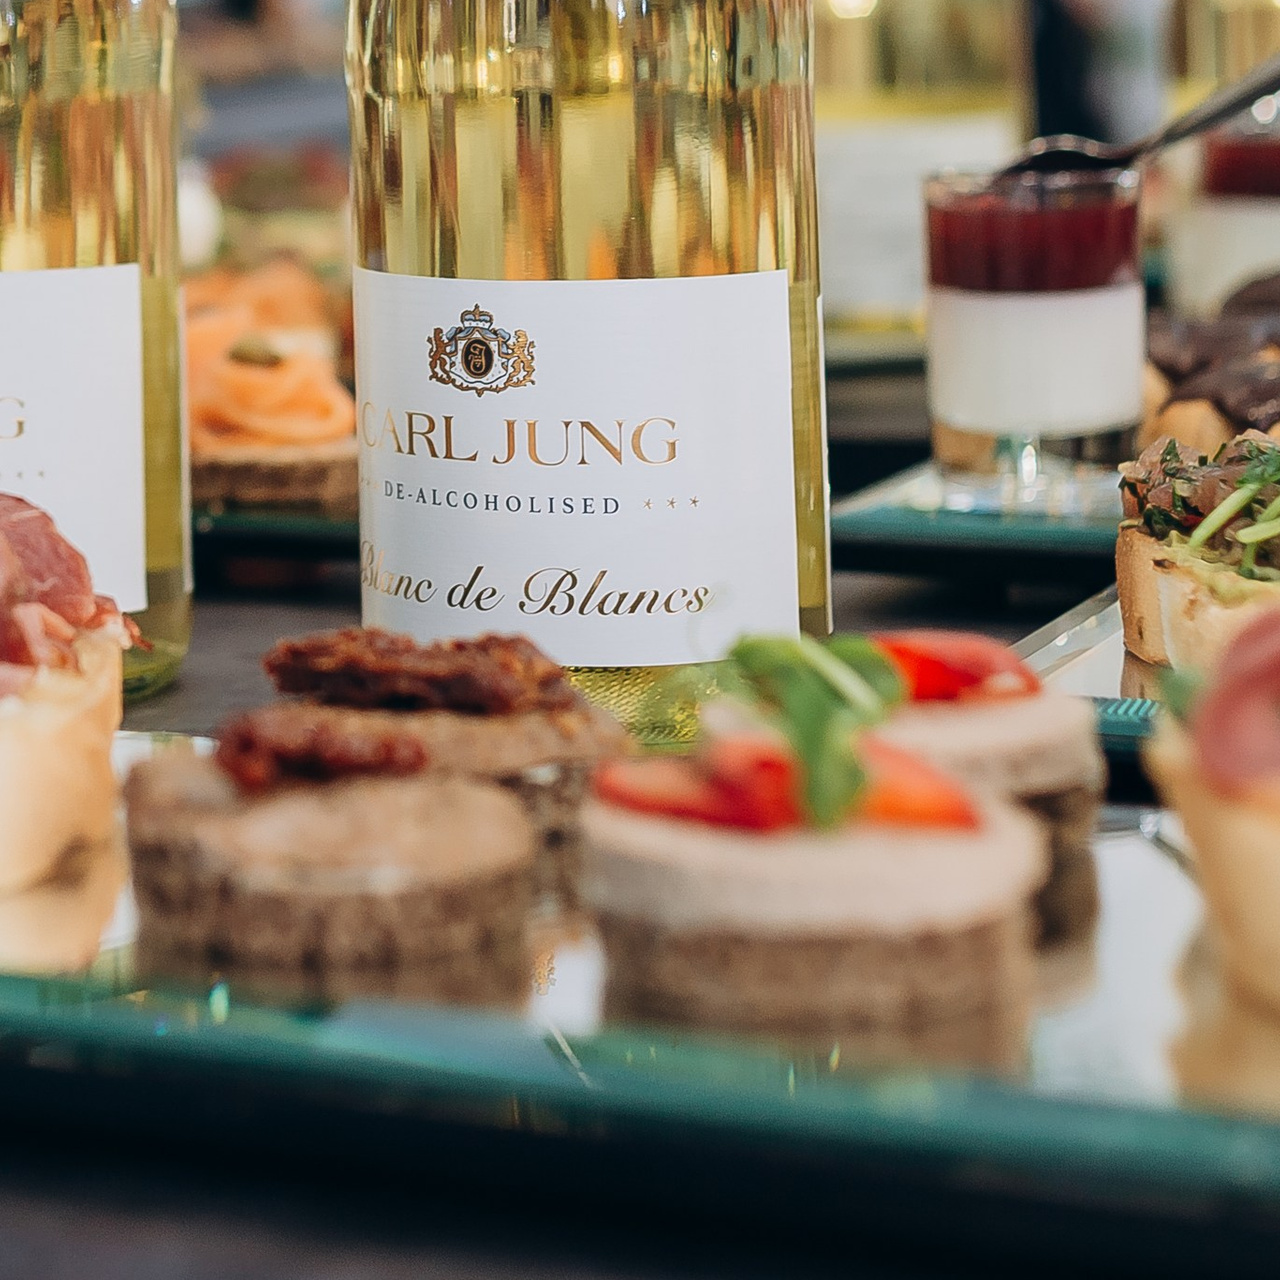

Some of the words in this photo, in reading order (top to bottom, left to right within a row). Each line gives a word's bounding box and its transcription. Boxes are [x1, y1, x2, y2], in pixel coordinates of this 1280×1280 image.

[361, 401, 479, 462] CARL
[492, 417, 680, 466] JUNG
[384, 480, 620, 515] DE-ALCOHOLISED
[446, 565, 506, 611] de
[518, 567, 716, 617] Blancs
